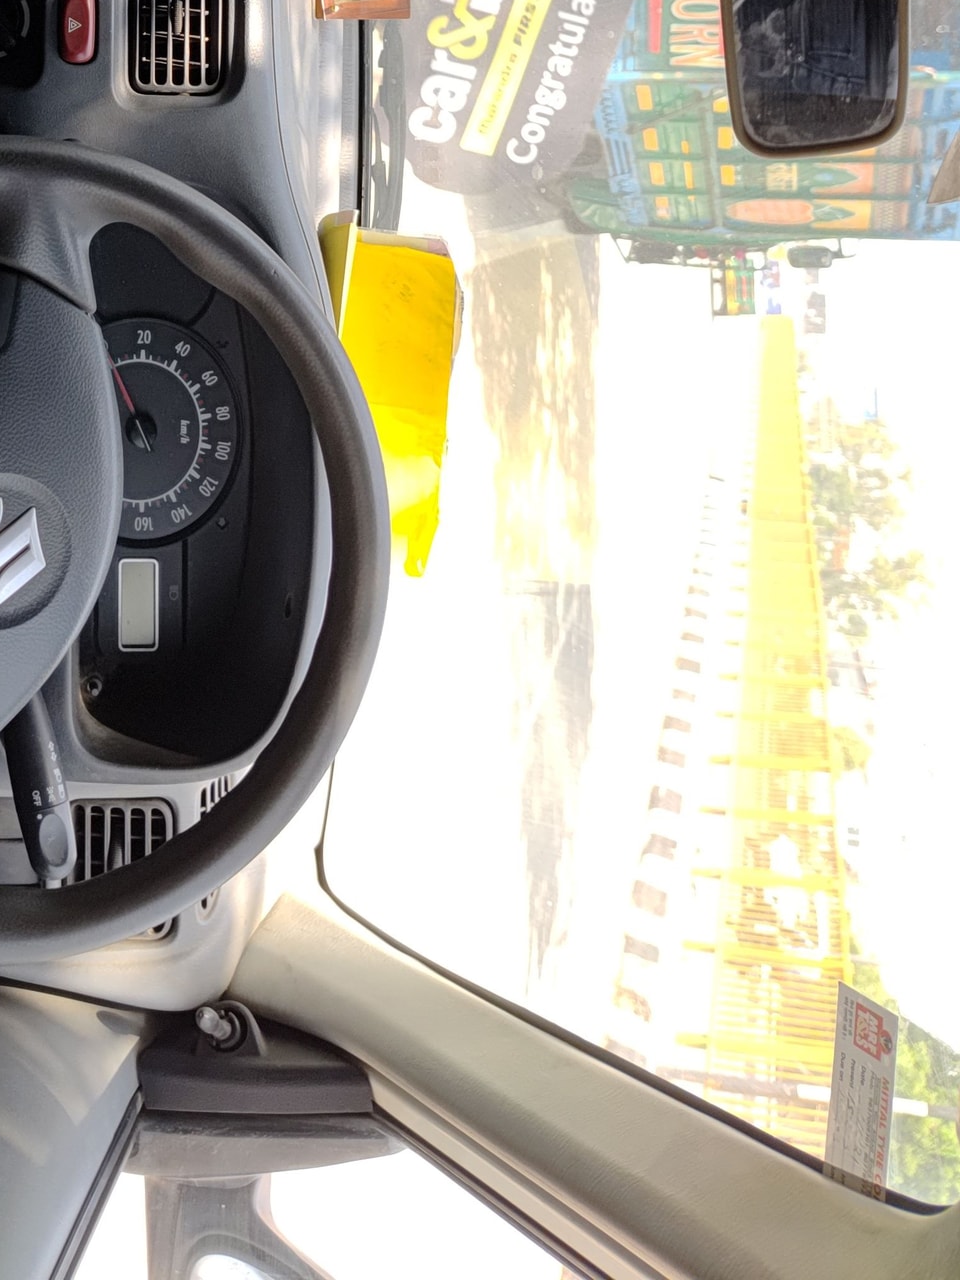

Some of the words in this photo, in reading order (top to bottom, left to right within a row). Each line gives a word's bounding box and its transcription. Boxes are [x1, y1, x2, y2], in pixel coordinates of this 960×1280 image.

[136, 330, 152, 344] 20
[174, 340, 191, 357] 40
[201, 370, 218, 386] 60
[215, 406, 230, 421] 80
[180, 419, 190, 444] km/h
[214, 441, 231, 461] 100
[198, 476, 219, 497] 120
[134, 517, 154, 531] 160
[170, 504, 192, 524] 140
[32, 790, 42, 807] OFF
[867, 1014, 879, 1056] MRF
[879, 1076, 890, 1129] MITTAL
[875, 1135, 886, 1168] TYRE
